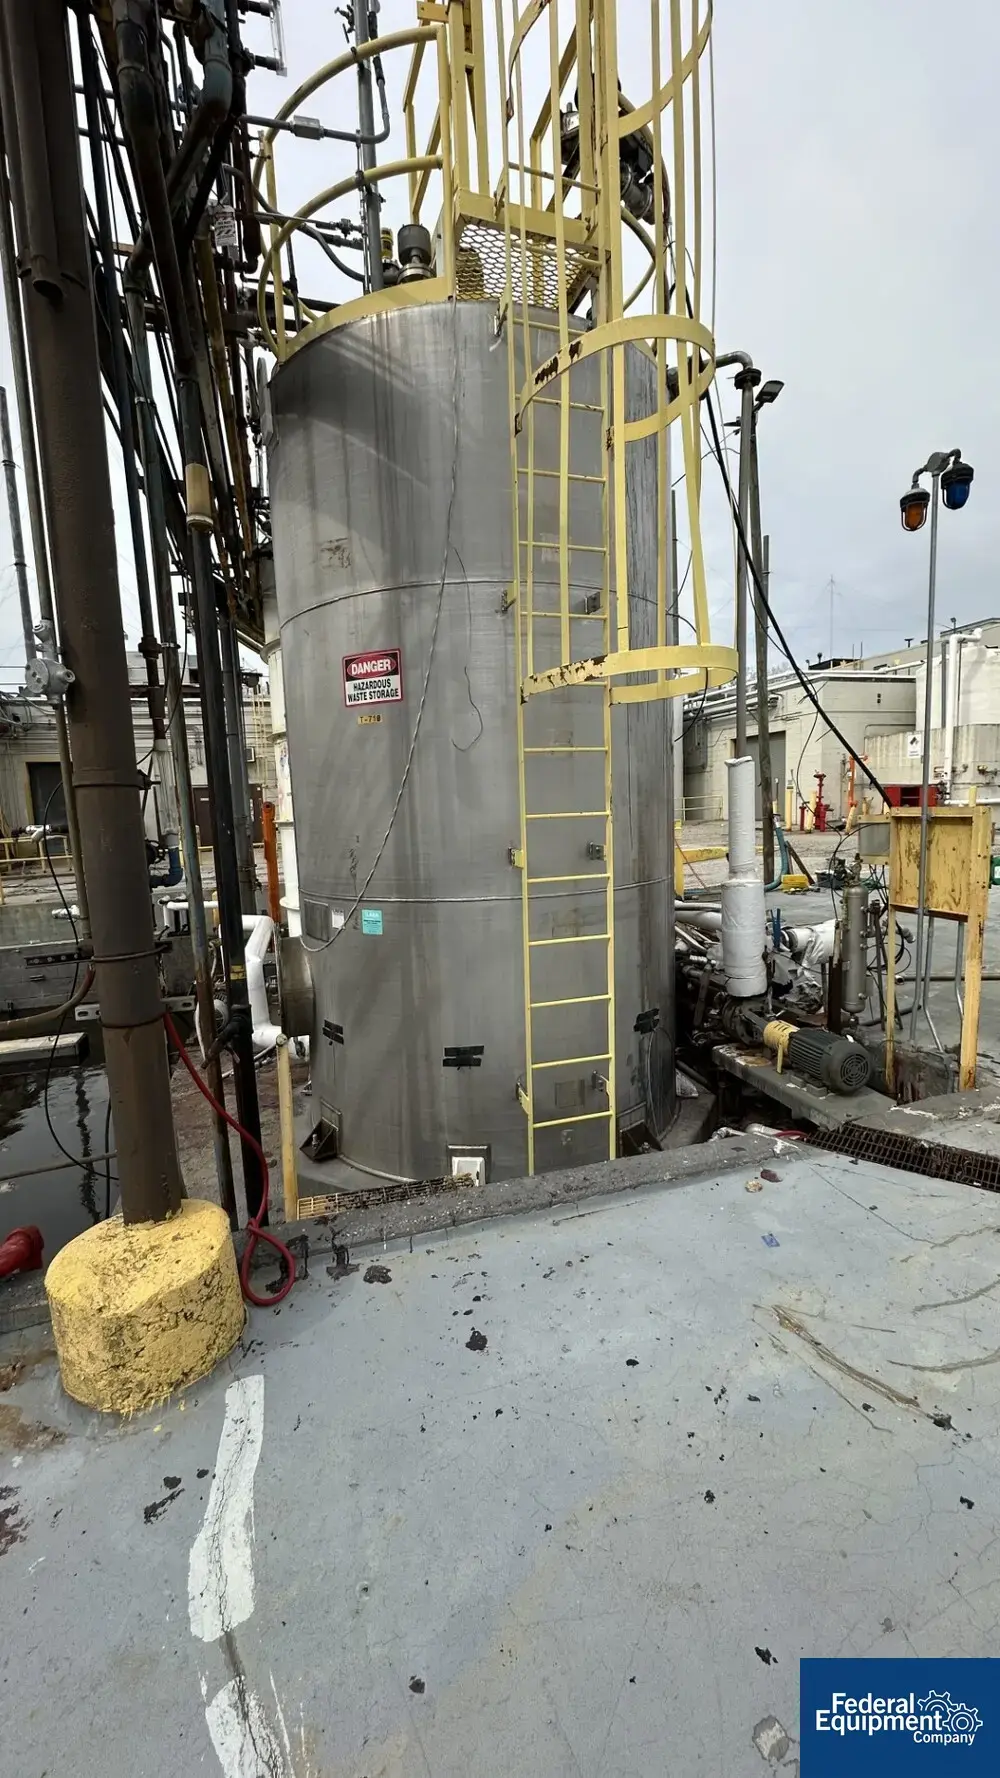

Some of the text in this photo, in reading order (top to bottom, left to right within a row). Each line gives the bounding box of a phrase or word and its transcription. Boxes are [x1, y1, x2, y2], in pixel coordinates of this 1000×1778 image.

[351, 659, 391, 676] DANGER
[353, 679, 391, 691] HAZARDOUS
[348, 688, 399, 702] WASTE STORAGE
